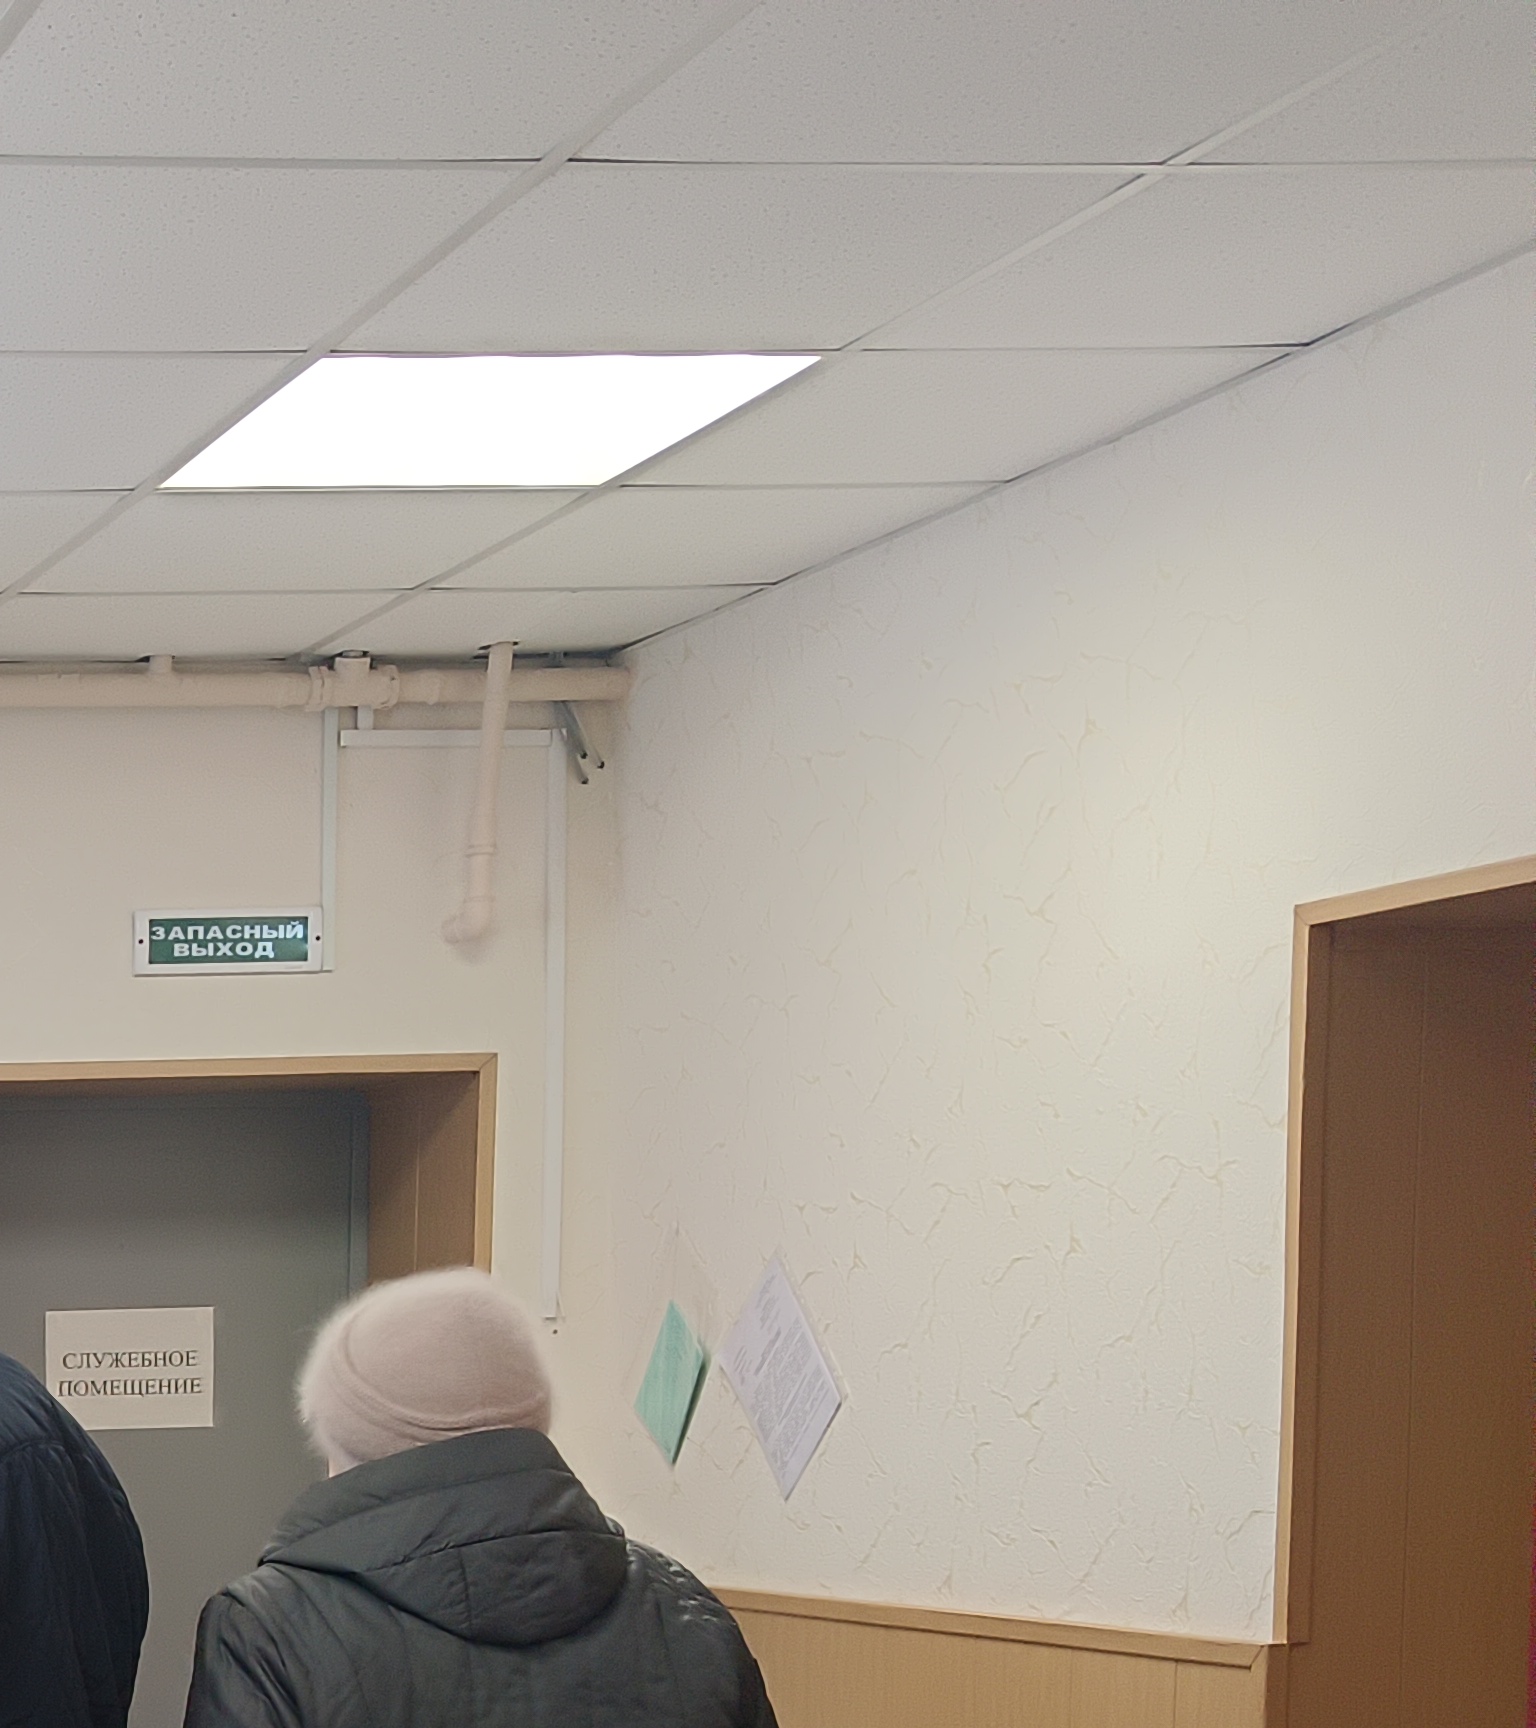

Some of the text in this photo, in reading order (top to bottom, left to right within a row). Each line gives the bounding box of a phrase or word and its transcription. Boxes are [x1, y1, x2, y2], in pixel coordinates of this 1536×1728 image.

[150, 920, 304, 941] ЗАПАСНЫЙ
[173, 941, 275, 959] ВЫХОД
[61, 1350, 200, 1370] СЛУЖЕБНОЕ
[57, 1377, 203, 1398] ПОМЕЩЕНИЕ
